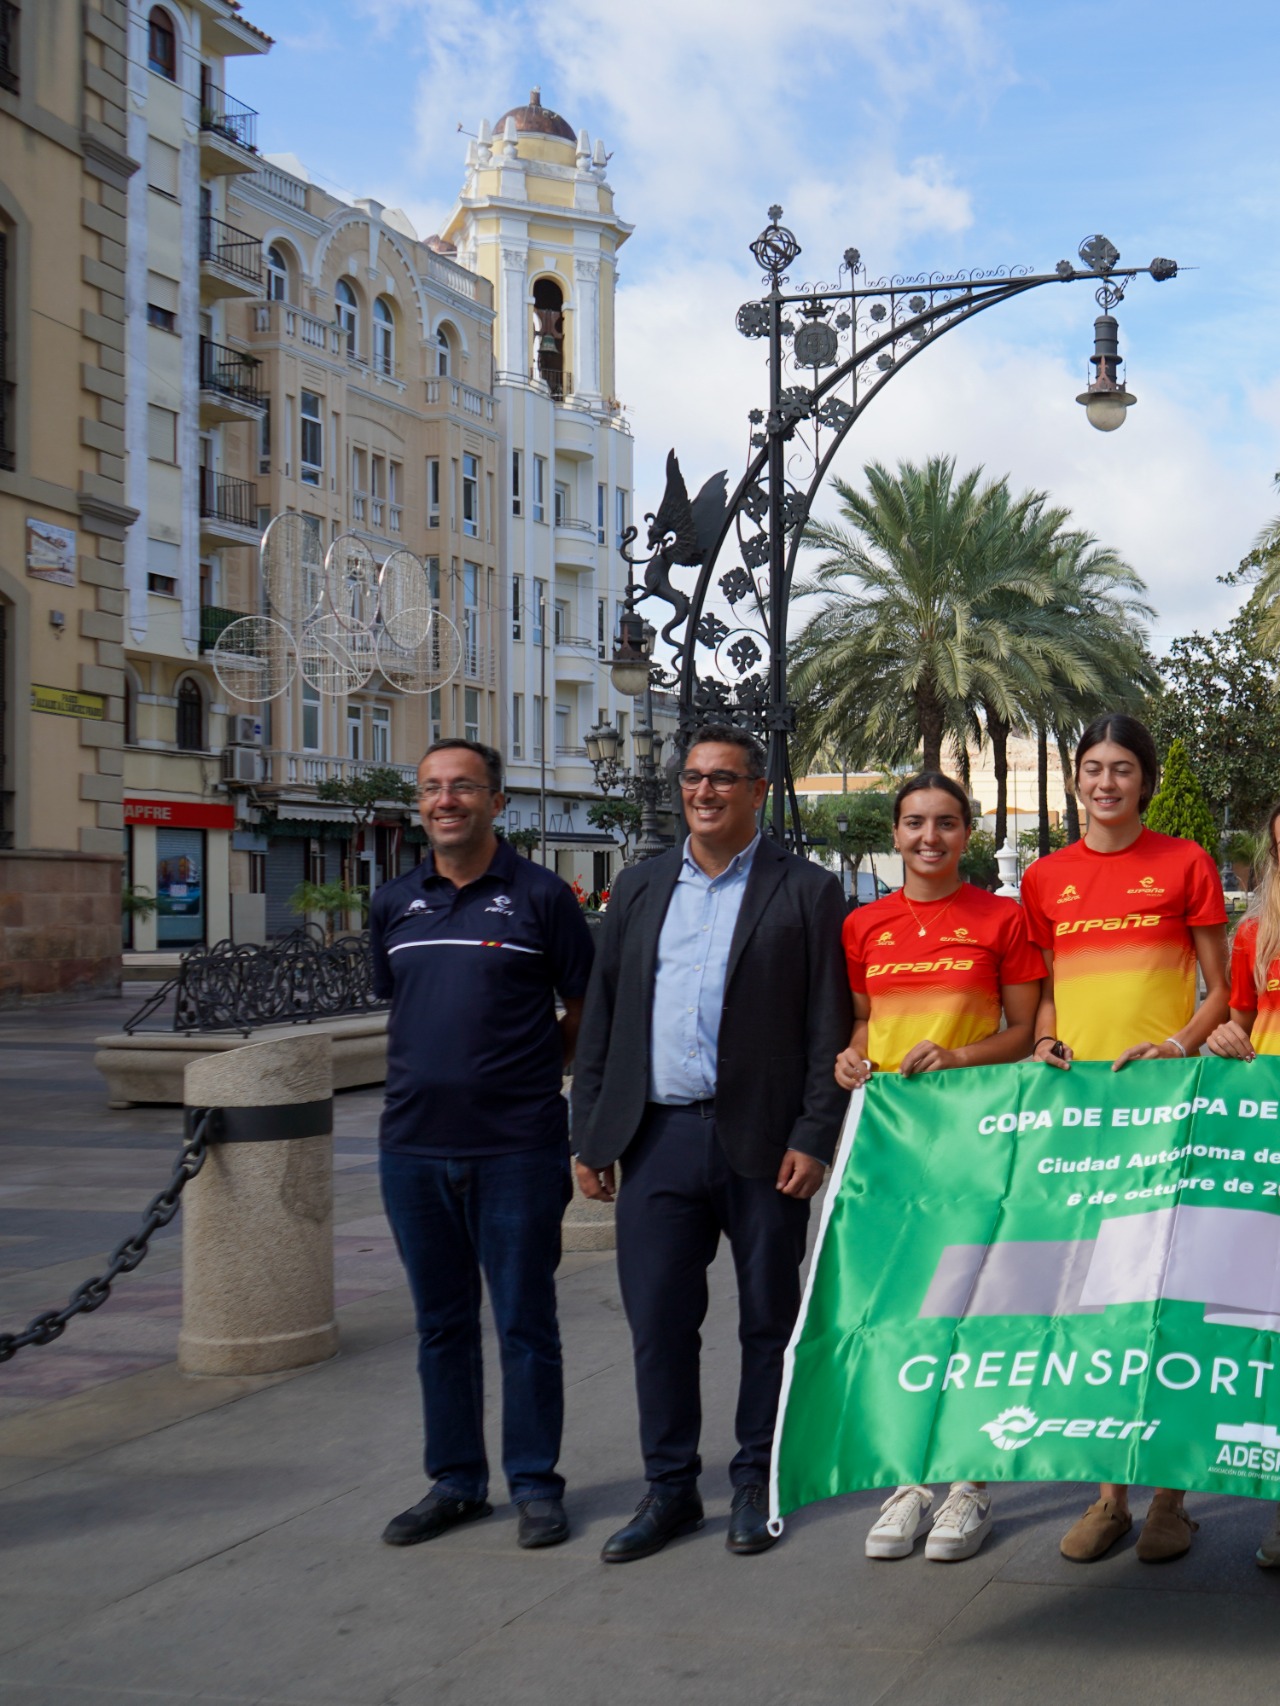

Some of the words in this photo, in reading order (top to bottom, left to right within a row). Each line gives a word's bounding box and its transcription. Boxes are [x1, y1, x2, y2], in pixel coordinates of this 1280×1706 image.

[124, 804, 172, 820] APFRE
[1056, 914, 1161, 936] españa
[866, 958, 974, 978] españa
[978, 1110, 1053, 1135] COPA
[1062, 1107, 1103, 1127] DE
[1111, 1097, 1228, 1127] EUROPA
[1238, 1100, 1279, 1120] DE
[1037, 1156, 1121, 1174] Ciudad
[1126, 1144, 1246, 1169] Autónoma
[1066, 1193, 1081, 1206] 6
[1087, 1190, 1117, 1205] de
[1124, 1177, 1215, 1200] octubre
[1223, 1178, 1254, 1194] de
